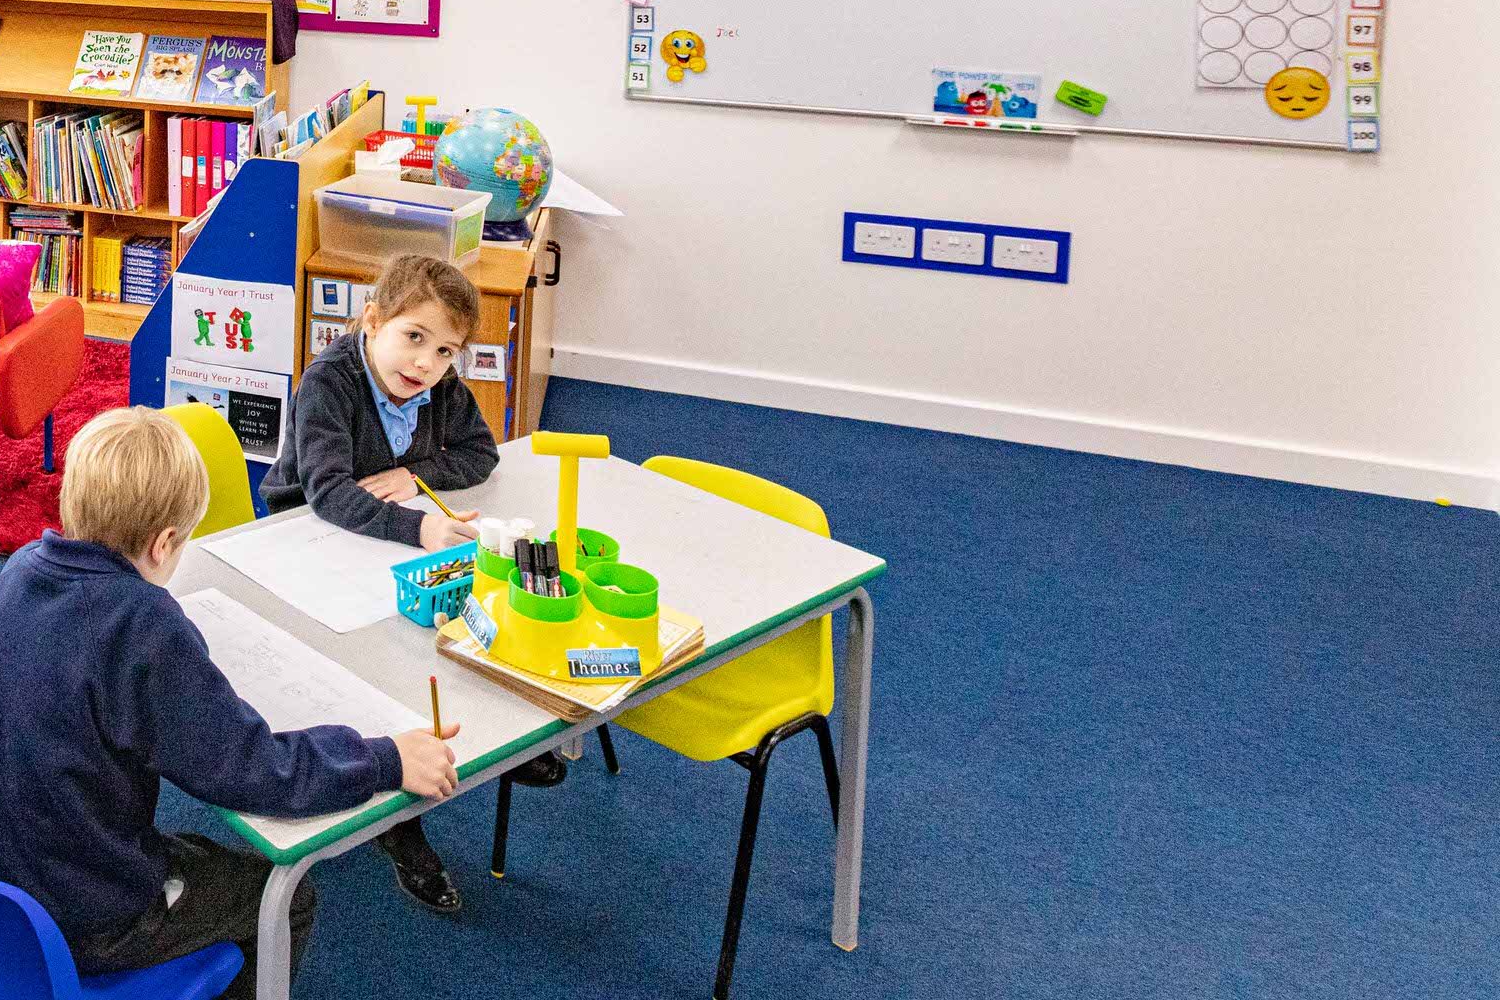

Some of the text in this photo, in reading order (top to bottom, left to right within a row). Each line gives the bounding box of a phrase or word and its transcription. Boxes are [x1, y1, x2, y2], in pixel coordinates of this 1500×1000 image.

[636, 14, 650, 24] 53
[1353, 25, 1372, 35] 97
[116, 34, 132, 45] You
[152, 36, 203, 48] FERGUS'S
[86, 44, 130, 54] Seen the
[633, 43, 647, 53] 52
[1352, 61, 1371, 73] 98
[632, 72, 645, 82] 51
[1352, 95, 1371, 105] 99
[1352, 131, 1378, 140] 100
[178, 281, 214, 296] January
[217, 287, 238, 296] Year
[249, 290, 274, 300] Trust
[171, 366, 268, 389] January Year 2 Trust
[244, 400, 277, 410] EXPERIENCE
[239, 419, 257, 427] WHEN
[239, 426, 257, 434] LEARN
[240, 437, 264, 447] TRUST
[462, 601, 489, 645] Thames
[583, 650, 612, 662] River
[570, 660, 630, 675] Thames
